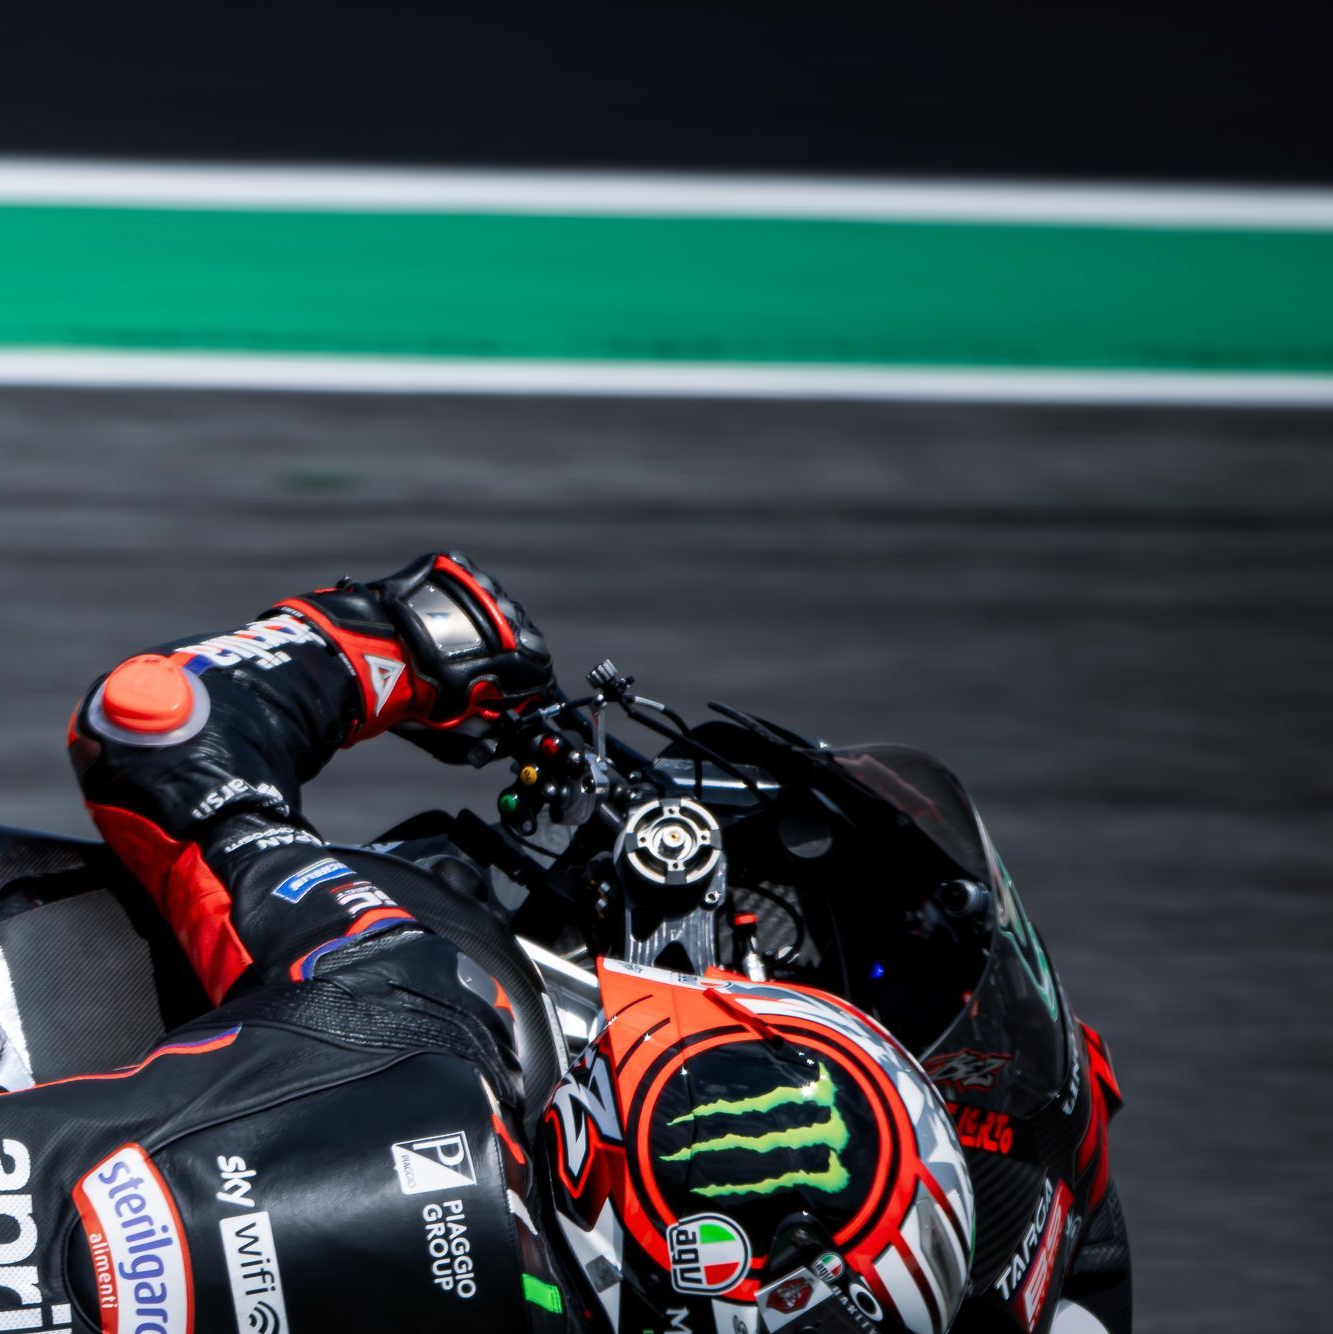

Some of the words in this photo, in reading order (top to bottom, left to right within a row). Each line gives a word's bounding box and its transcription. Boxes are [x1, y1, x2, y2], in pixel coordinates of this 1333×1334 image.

[217, 1155, 258, 1207] sky
[90, 1233, 118, 1309] alimenti
[422, 1203, 454, 1291] GROUP
[443, 1200, 476, 1298] PIAGGIO
[670, 1228, 703, 1287] agv
[994, 1166, 1052, 1299] TARGA
